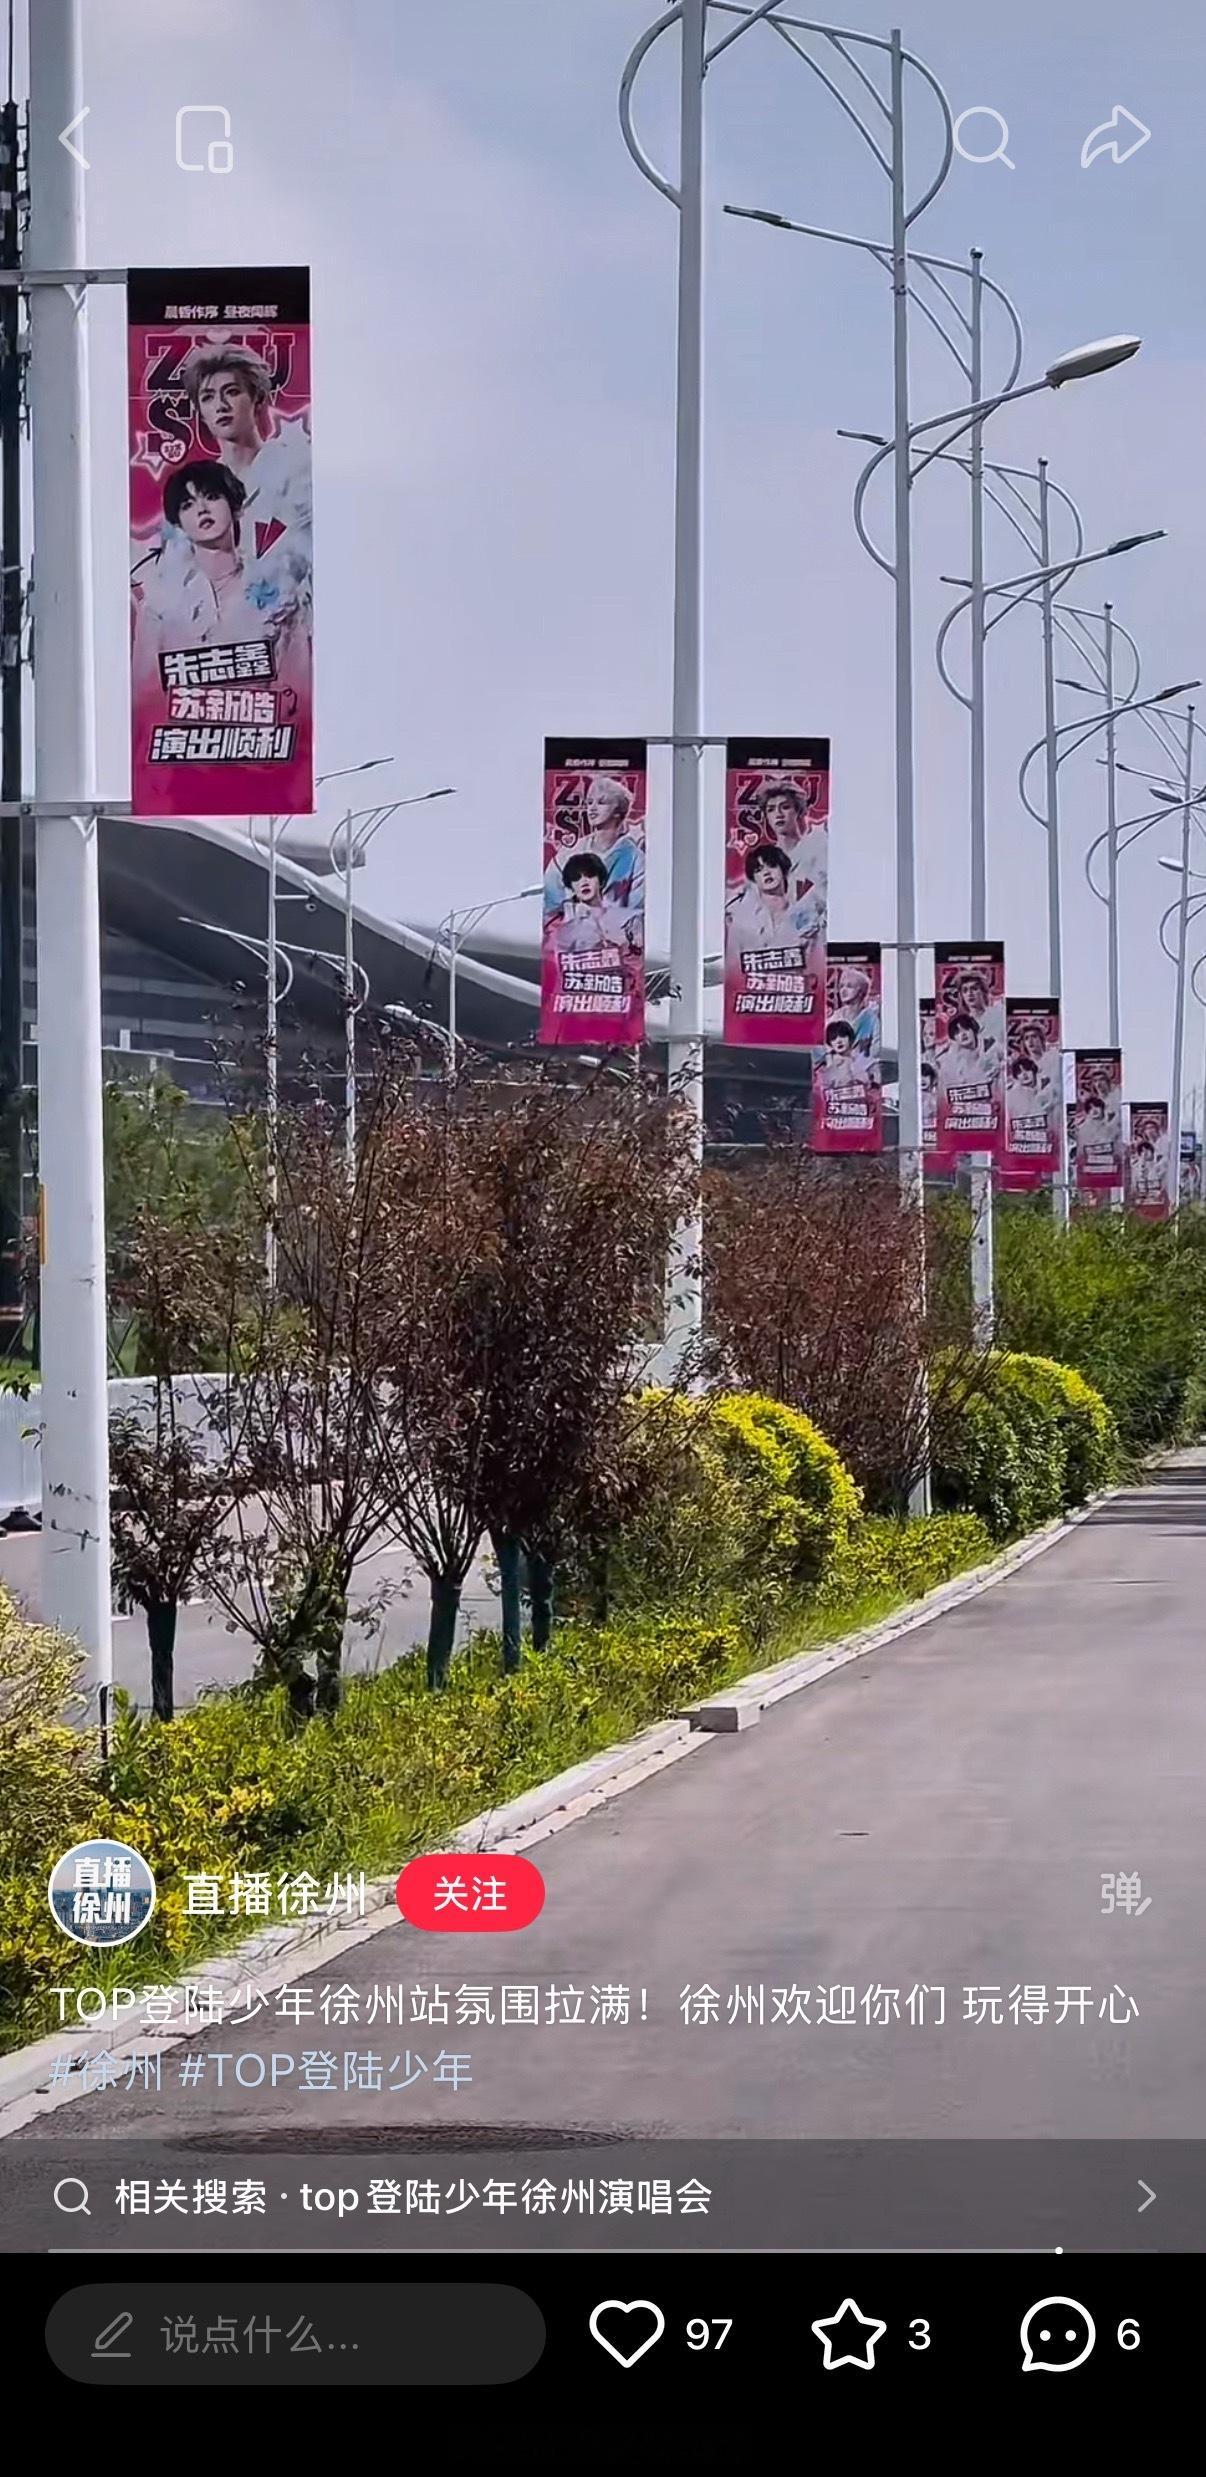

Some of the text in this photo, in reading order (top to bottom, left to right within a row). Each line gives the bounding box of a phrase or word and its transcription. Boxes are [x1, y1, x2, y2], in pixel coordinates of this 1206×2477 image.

[164, 643, 271, 686] 朱志鑫
[170, 687, 274, 723] 苏新皓
[151, 726, 292, 760] 演出顺利
